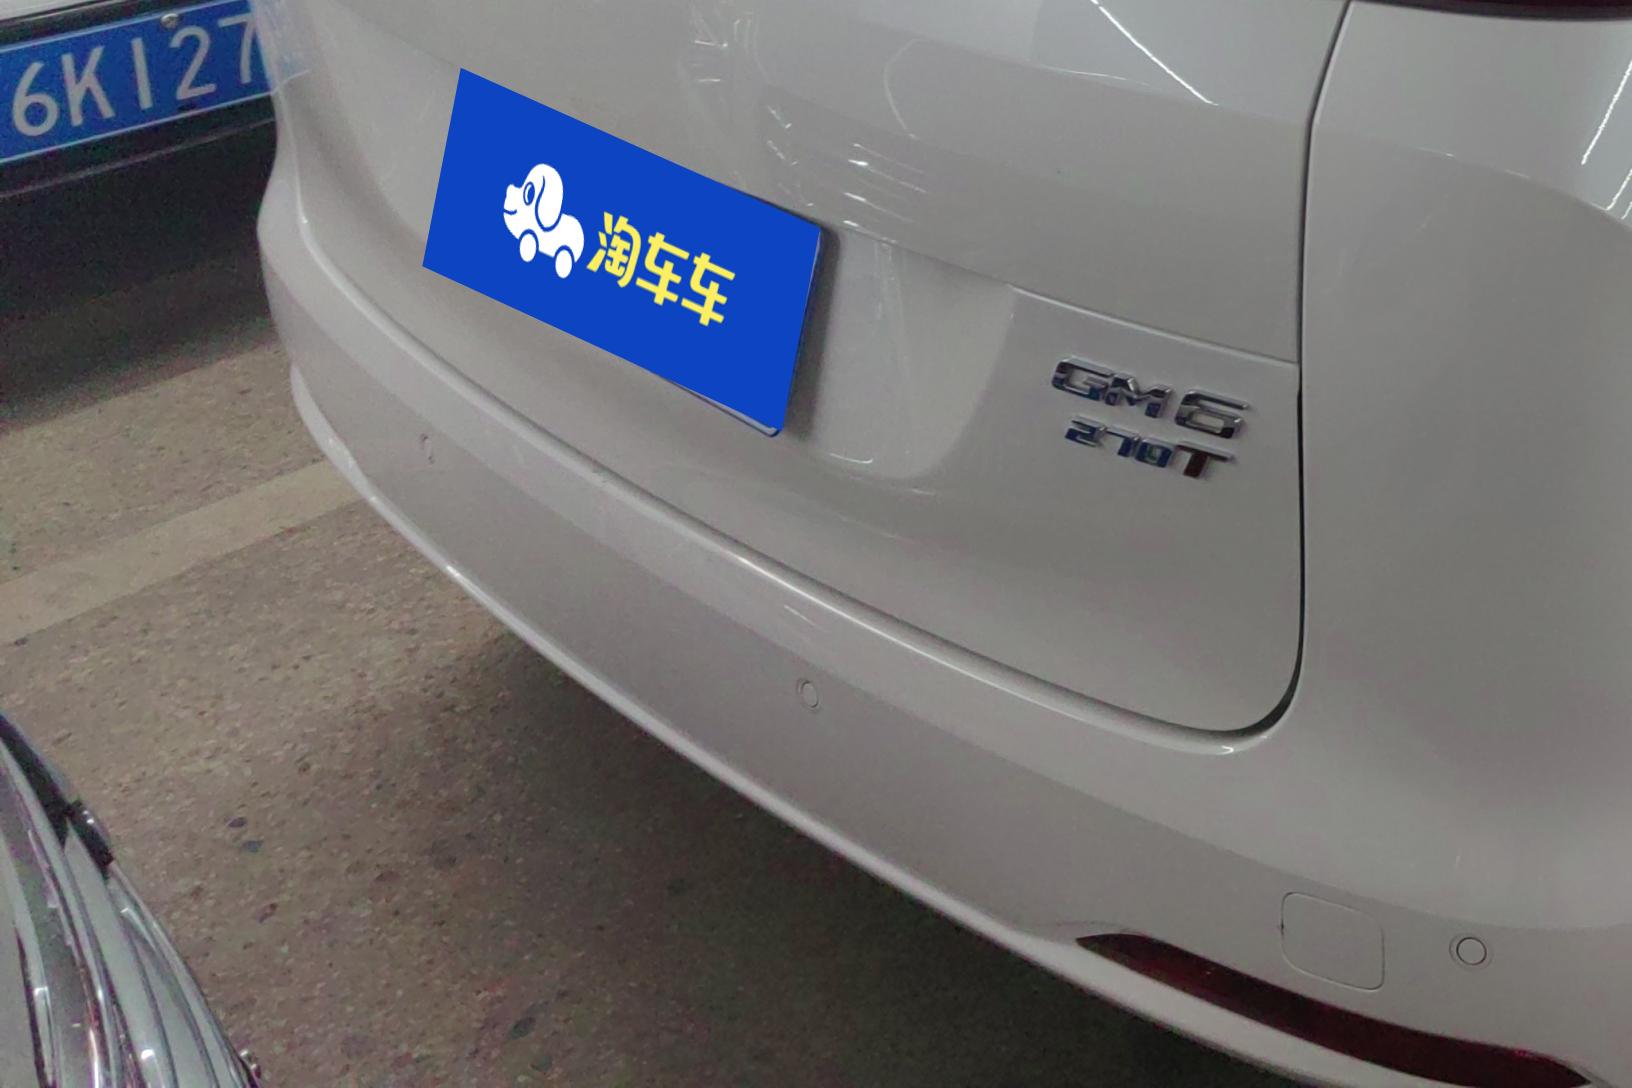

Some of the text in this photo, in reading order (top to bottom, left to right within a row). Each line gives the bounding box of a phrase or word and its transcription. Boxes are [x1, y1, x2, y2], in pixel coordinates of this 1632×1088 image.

[11, 12, 257, 137] 6K127
[1051, 355, 1251, 439] GM6
[1064, 415, 1237, 478] 270T
